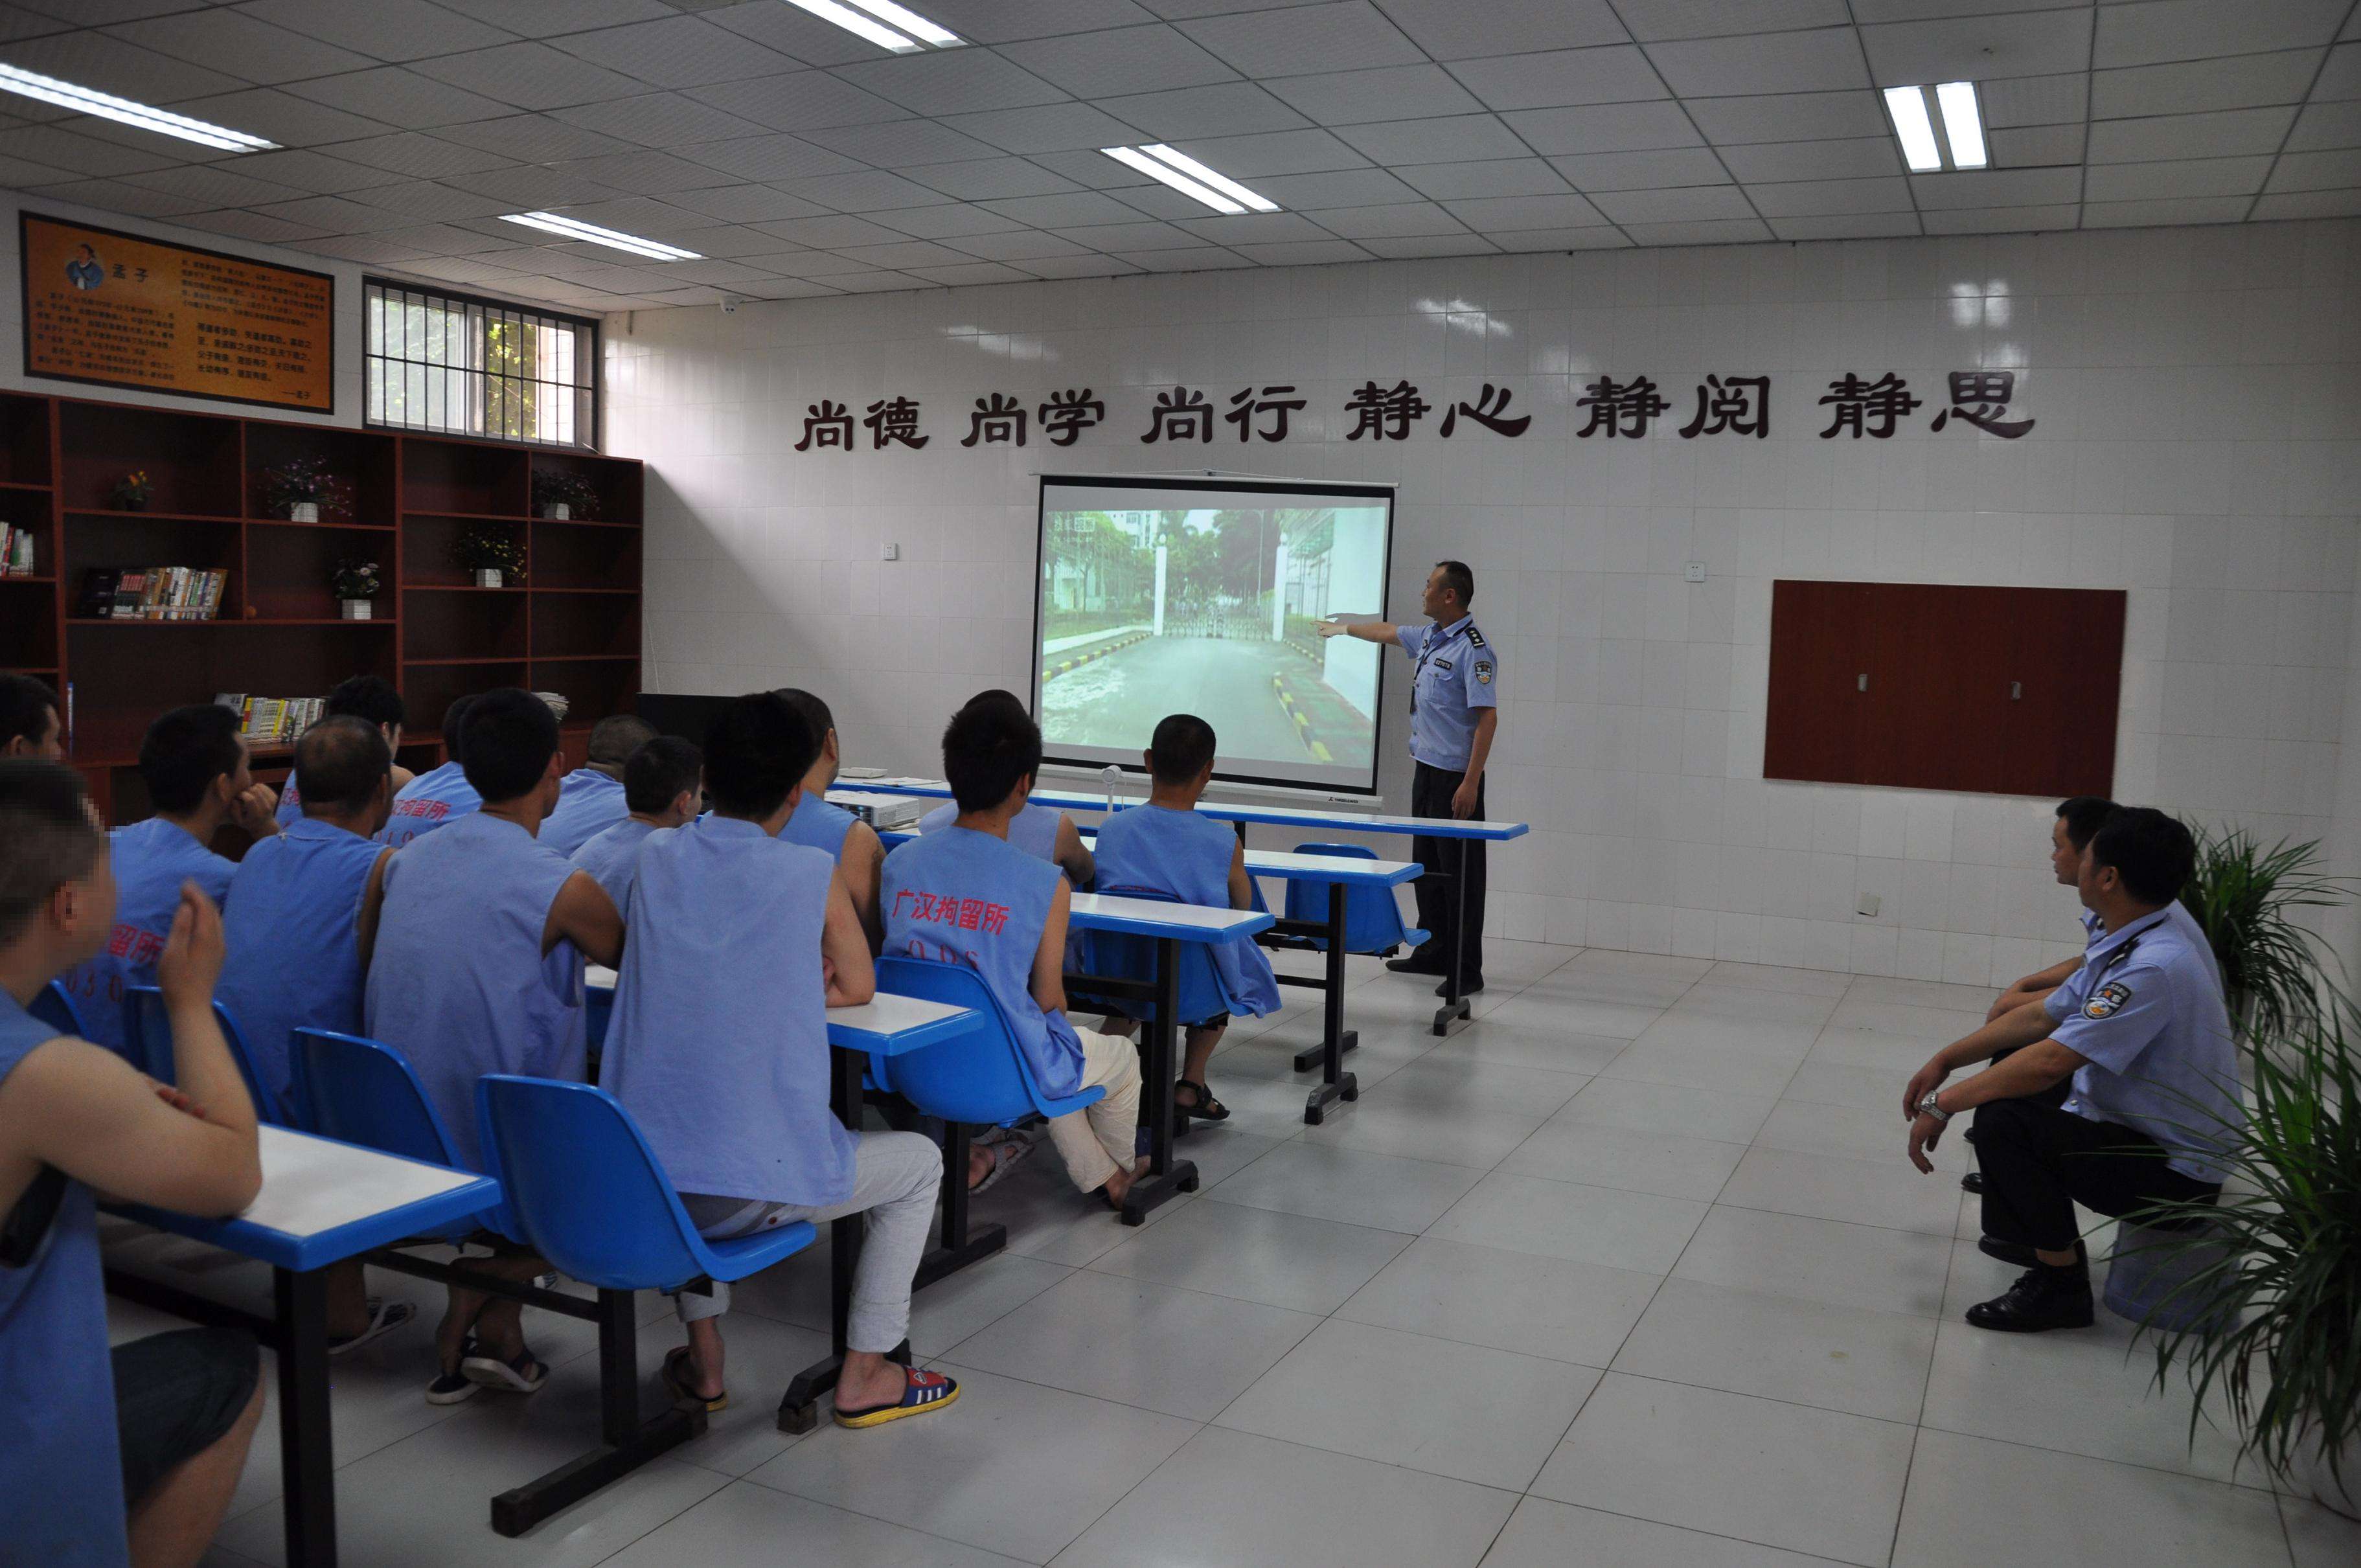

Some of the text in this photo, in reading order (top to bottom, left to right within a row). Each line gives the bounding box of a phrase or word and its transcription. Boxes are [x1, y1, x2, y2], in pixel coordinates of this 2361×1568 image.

[794, 371, 2035, 452] 尚德 尚学 尚行 静心 静阅 静思
[892, 889, 1010, 936] 广汉拘留所
